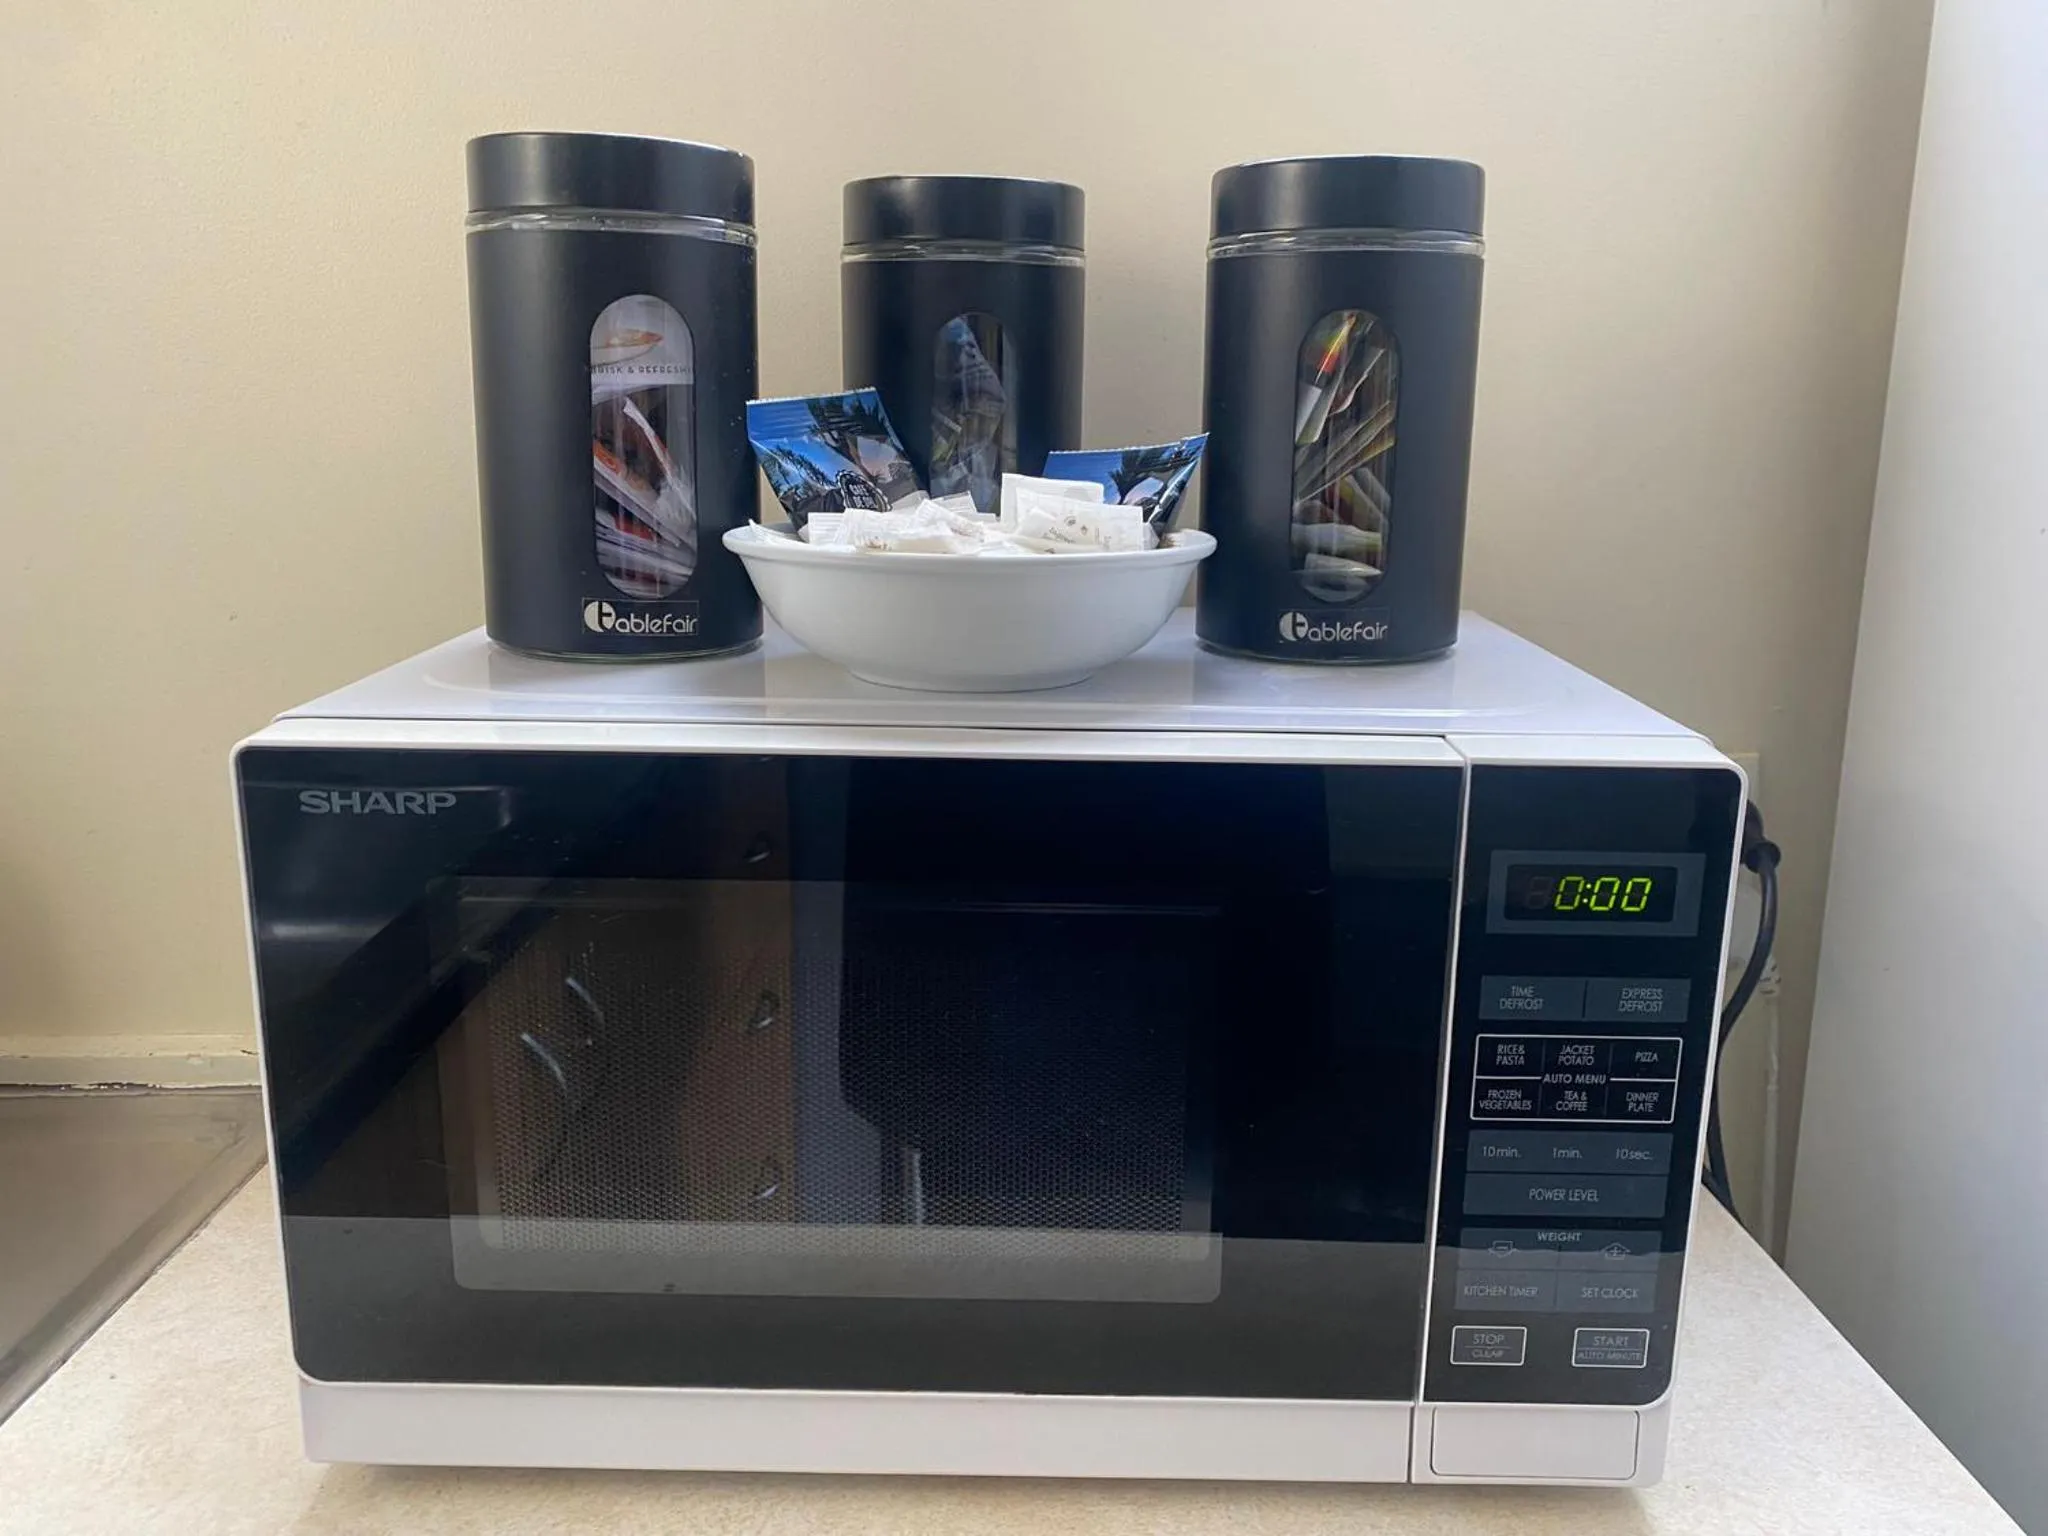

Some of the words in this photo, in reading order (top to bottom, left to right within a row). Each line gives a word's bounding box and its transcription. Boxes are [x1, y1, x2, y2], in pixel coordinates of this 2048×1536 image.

[299, 790, 457, 814] SHARP
[1555, 876, 1652, 911] 0:00
[1511, 986, 1534, 997] TIME
[1622, 988, 1663, 1000] EXPRESS
[1499, 998, 1543, 1010] DEFROST
[1619, 1000, 1662, 1012] DEFROST
[1560, 1045, 1595, 1055] JACKET
[1496, 1056, 1525, 1066] PASTA
[1558, 1056, 1594, 1066] POTATO
[1635, 1052, 1658, 1062] PIZZA
[1543, 1074, 1572, 1084] AUTO
[1575, 1074, 1607, 1084] MENU
[1488, 1090, 1522, 1099] FROZEN
[1564, 1091, 1579, 1100] TEA
[1626, 1092, 1659, 1102] DINNER
[1479, 1100, 1532, 1110] VEGETABLES
[1556, 1101, 1588, 1112] COFFEE
[1628, 1102, 1654, 1112] PLATE
[1529, 1188, 1566, 1200] POWER
[1569, 1189, 1599, 1202] LEVEL
[1537, 1232, 1582, 1242] WEIGHT
[1464, 1286, 1506, 1296] KITCHEN
[1508, 1287, 1538, 1297] TIMER
[1581, 1287, 1600, 1298] SET
[1603, 1288, 1639, 1299] CLOCK
[1473, 1334, 1504, 1345] STOP
[1593, 1335, 1628, 1346] START
